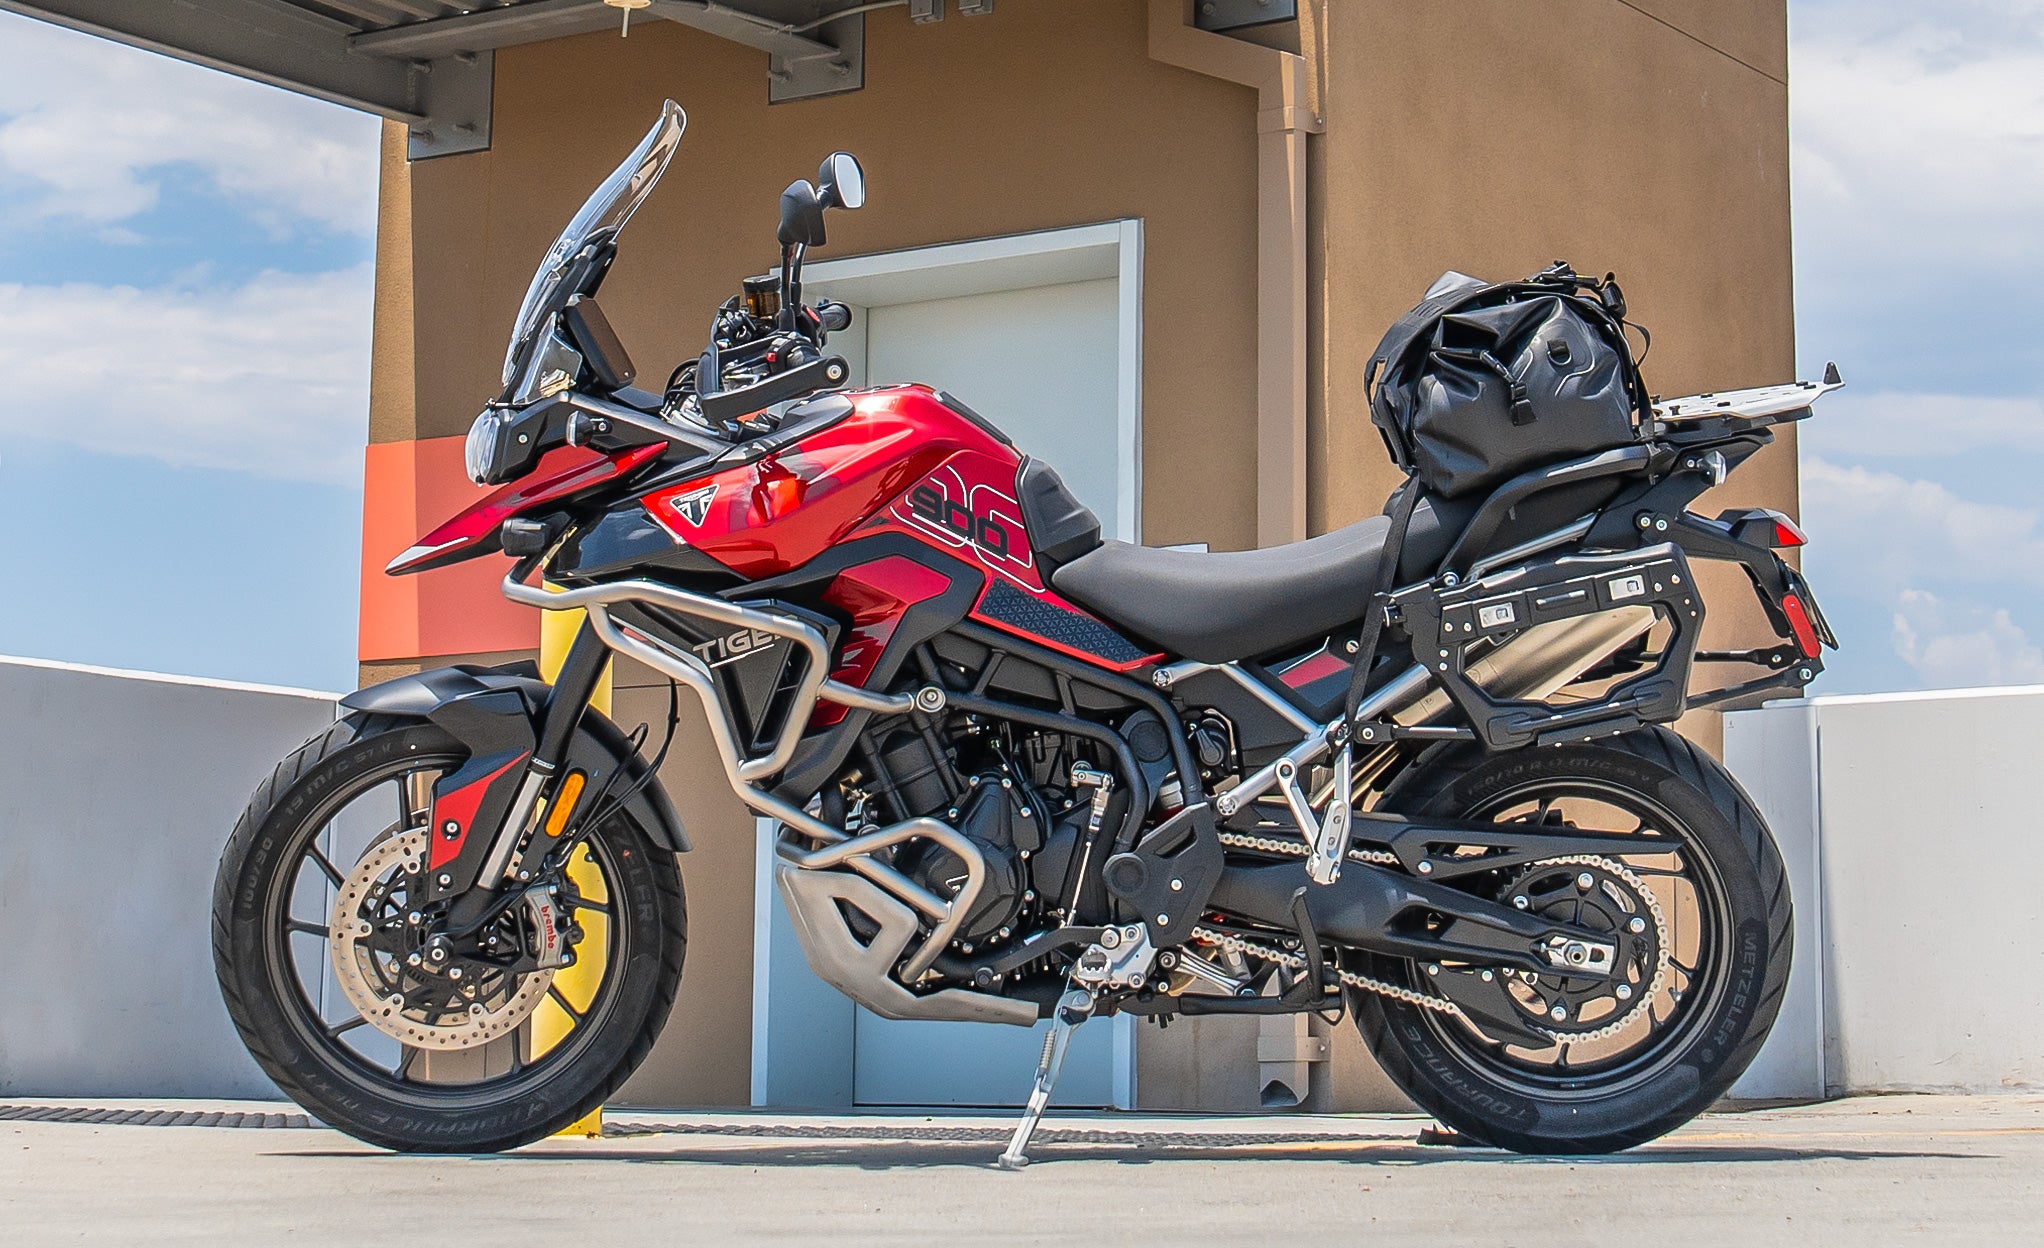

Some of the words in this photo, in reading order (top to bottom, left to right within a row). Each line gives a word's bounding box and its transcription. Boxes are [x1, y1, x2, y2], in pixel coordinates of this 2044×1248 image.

[911, 484, 1009, 561] 900
[692, 628, 782, 663] TIGE
[540, 905, 556, 950] brembo
[1713, 931, 1758, 1046] METZELER
[1401, 1024, 1527, 1121] TOURANCE
